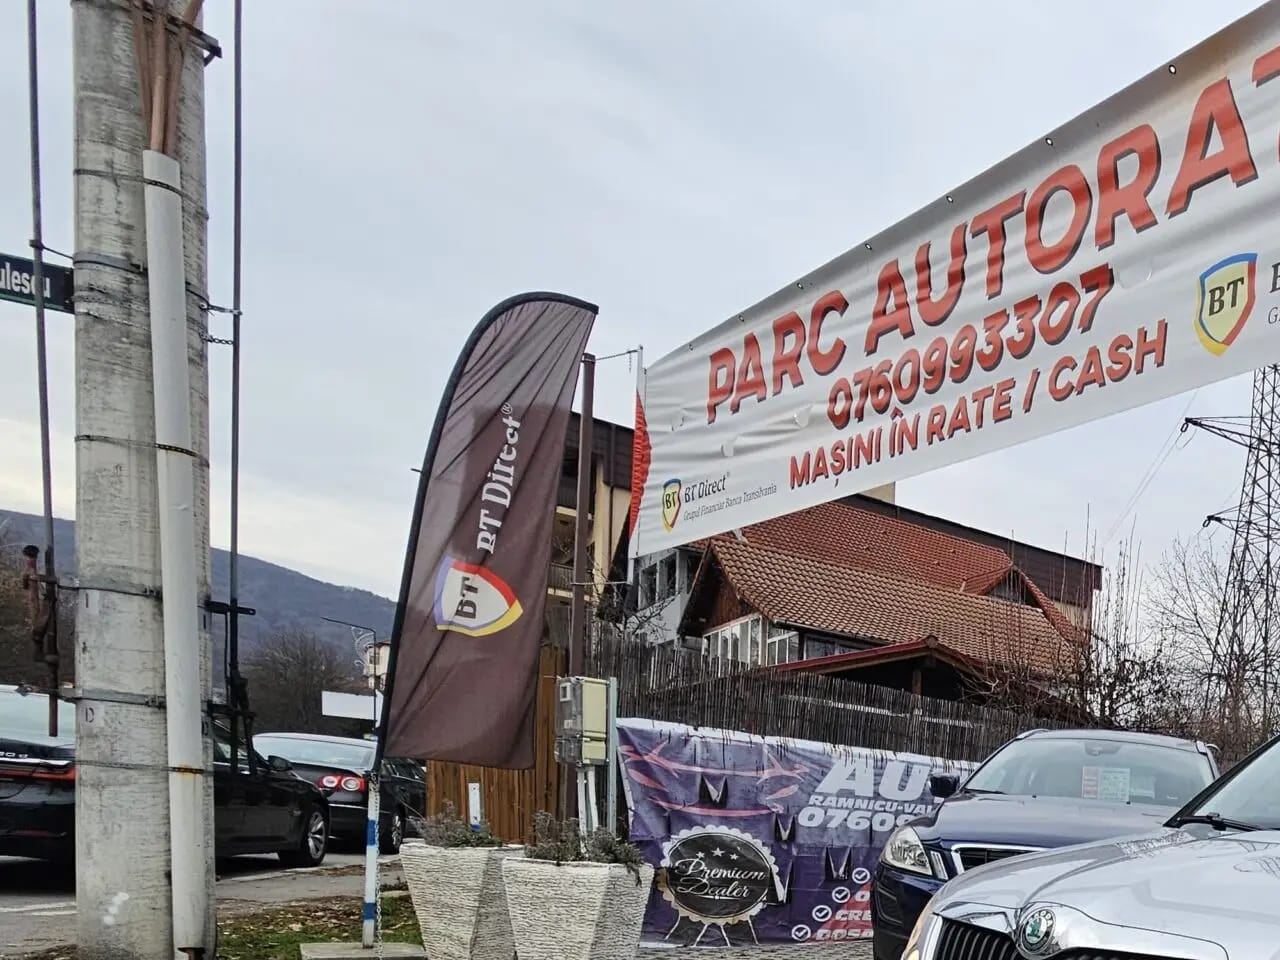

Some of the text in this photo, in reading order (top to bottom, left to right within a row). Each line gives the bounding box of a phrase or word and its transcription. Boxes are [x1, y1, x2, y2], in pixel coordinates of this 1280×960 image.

[1208, 277, 1246, 317] BT
[707, 290, 849, 424] PARC
[827, 263, 1115, 430] 0760993307
[888, 404, 920, 457] ÎN
[925, 377, 1016, 446] RATE
[1048, 318, 1169, 401] CASH
[665, 491, 677, 509] BT
[684, 484, 697, 503] BT
[455, 576, 479, 620] BT
[815, 757, 944, 803] AU
[675, 858, 766, 880] Premium
[676, 877, 751, 898] Dealer
